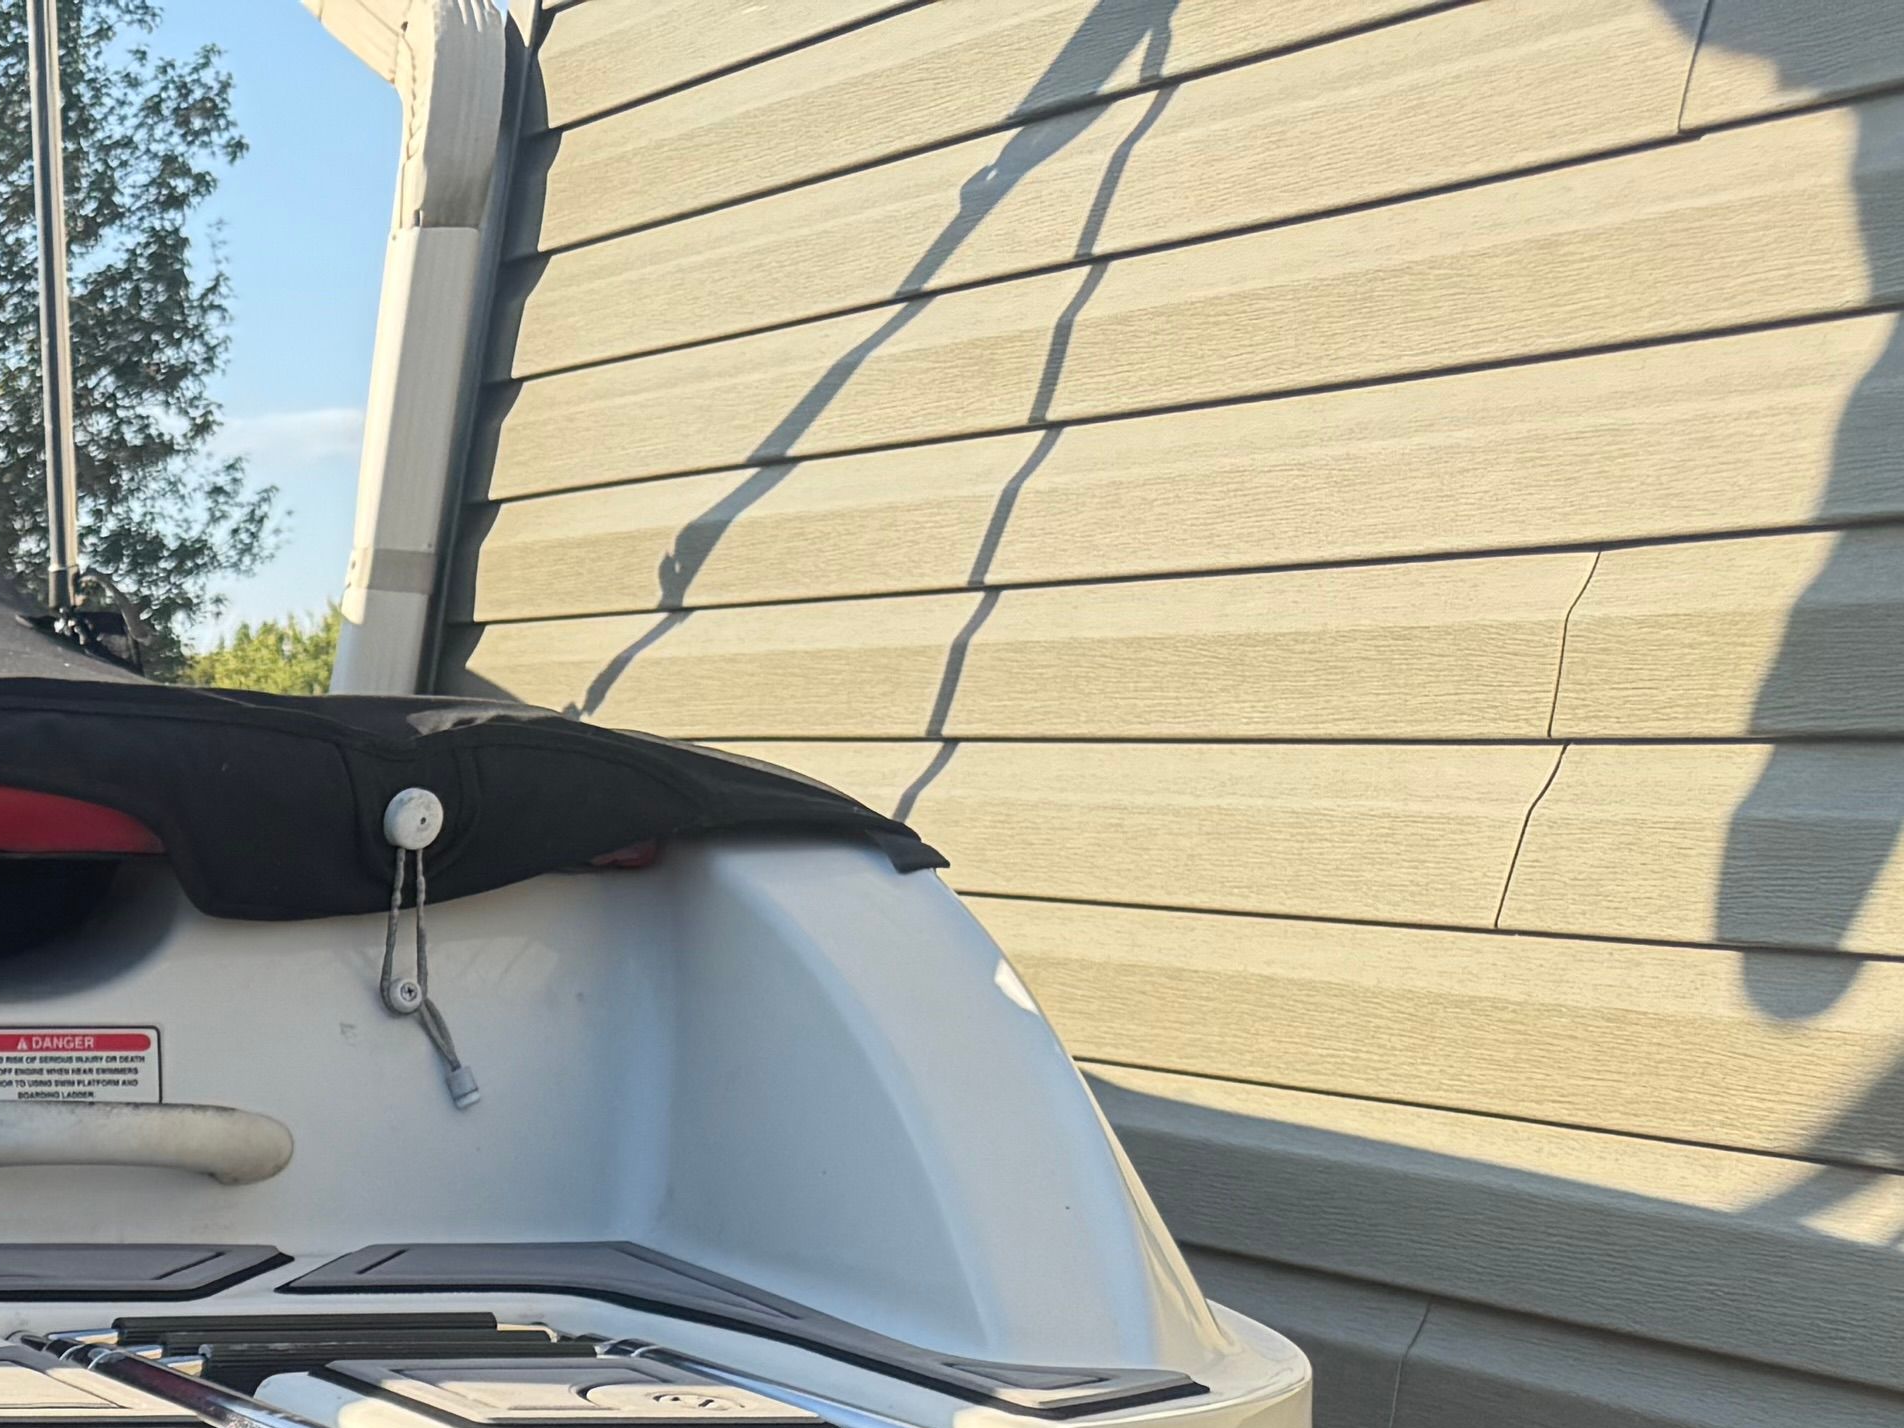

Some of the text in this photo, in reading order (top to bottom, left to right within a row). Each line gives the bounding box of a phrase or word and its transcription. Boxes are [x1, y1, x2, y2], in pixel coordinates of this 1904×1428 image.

[32, 1036, 95, 1049] DANGER
[25, 1056, 37, 1064] OF
[77, 1079, 120, 1087] PLATFORM
